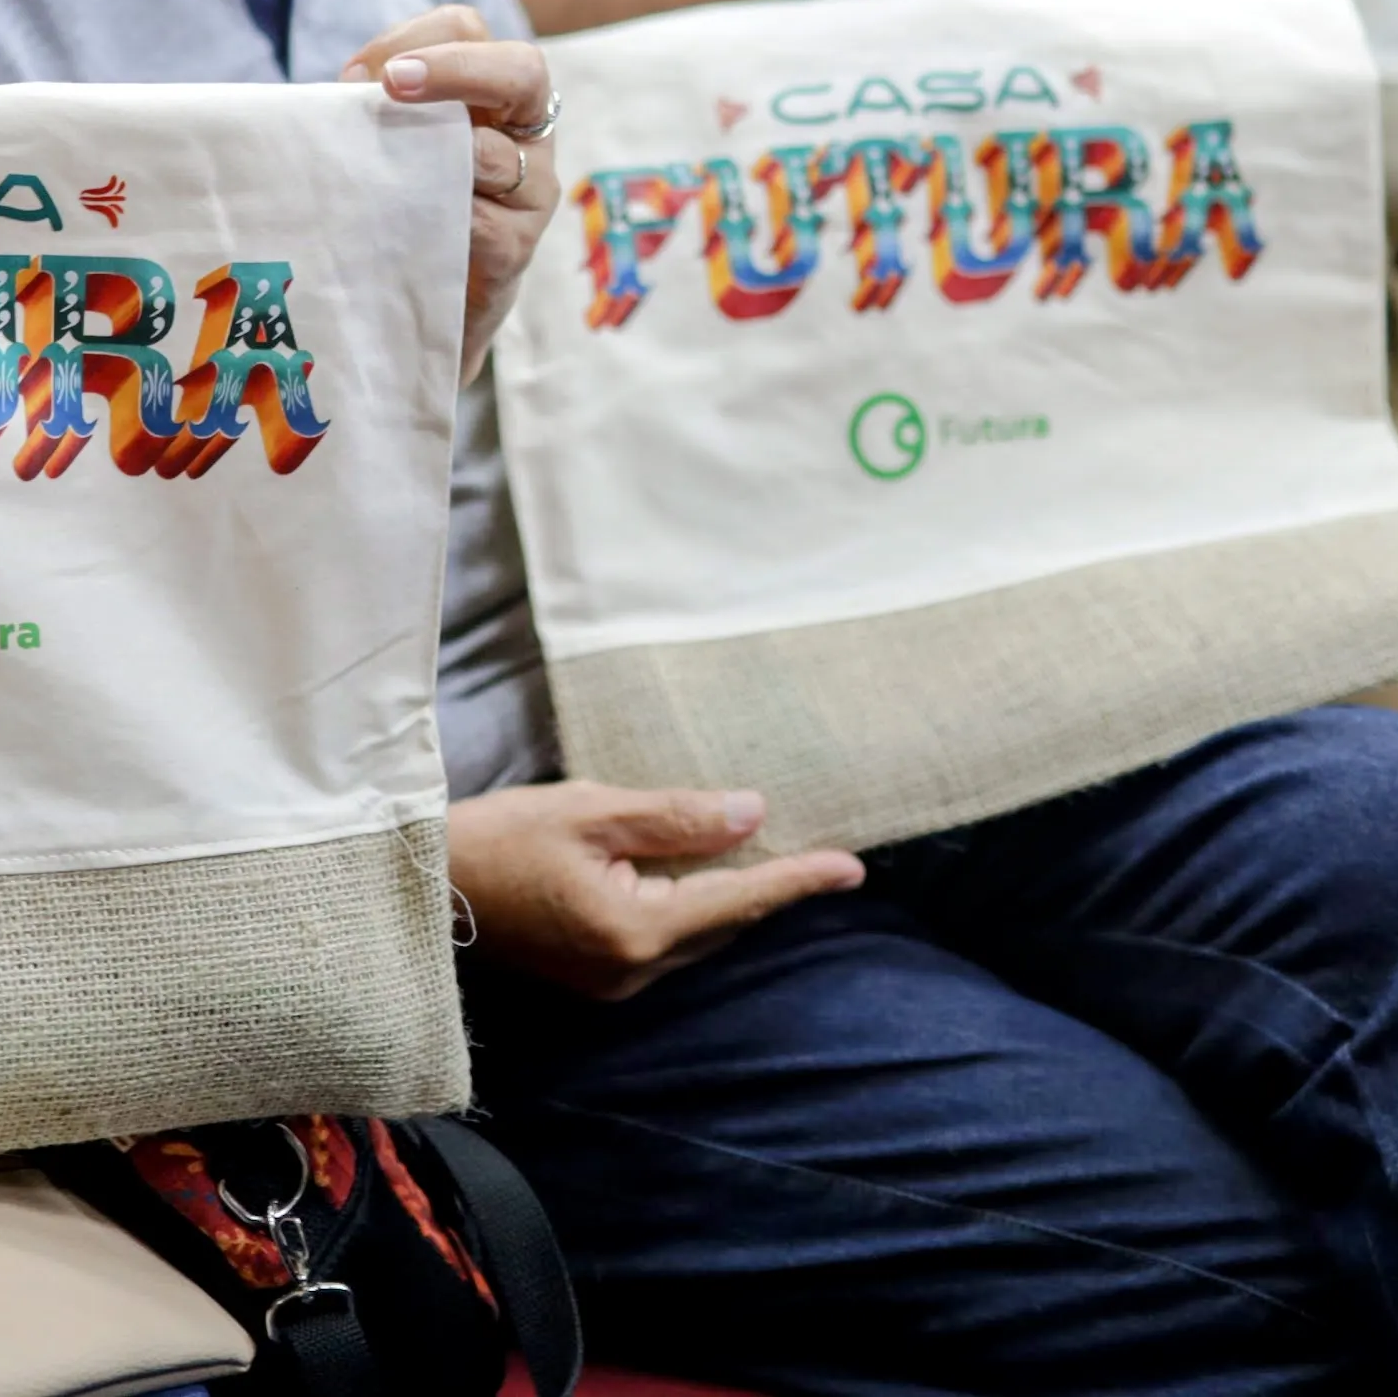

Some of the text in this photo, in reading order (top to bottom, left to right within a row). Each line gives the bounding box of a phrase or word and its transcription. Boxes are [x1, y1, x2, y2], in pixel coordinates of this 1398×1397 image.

[769, 65, 1060, 126] CASA
[570, 118, 1266, 332] FUTURA
[938, 413, 1050, 447] Futura
